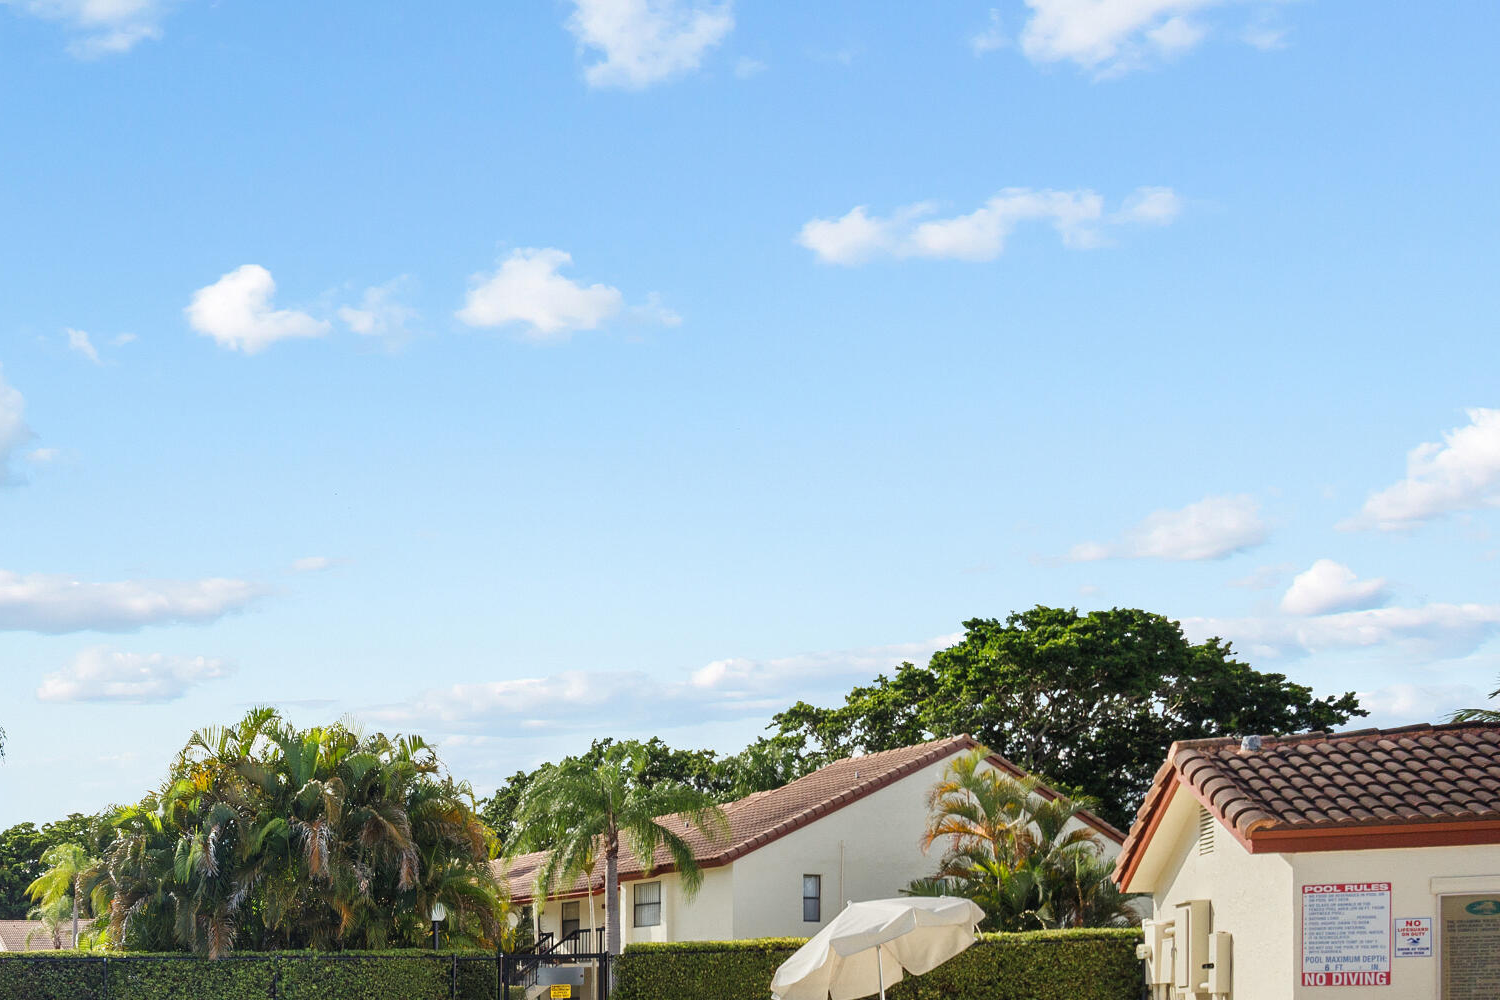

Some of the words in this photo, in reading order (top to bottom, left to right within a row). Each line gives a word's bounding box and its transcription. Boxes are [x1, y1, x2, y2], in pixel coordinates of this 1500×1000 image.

[1304, 885, 1341, 893] POOL
[1345, 883, 1389, 892] RULES
[1305, 956, 1324, 964] POOL
[1325, 955, 1360, 963] MAXIMUM
[1304, 973, 1327, 986] NO
[1332, 972, 1387, 986] DIVING
